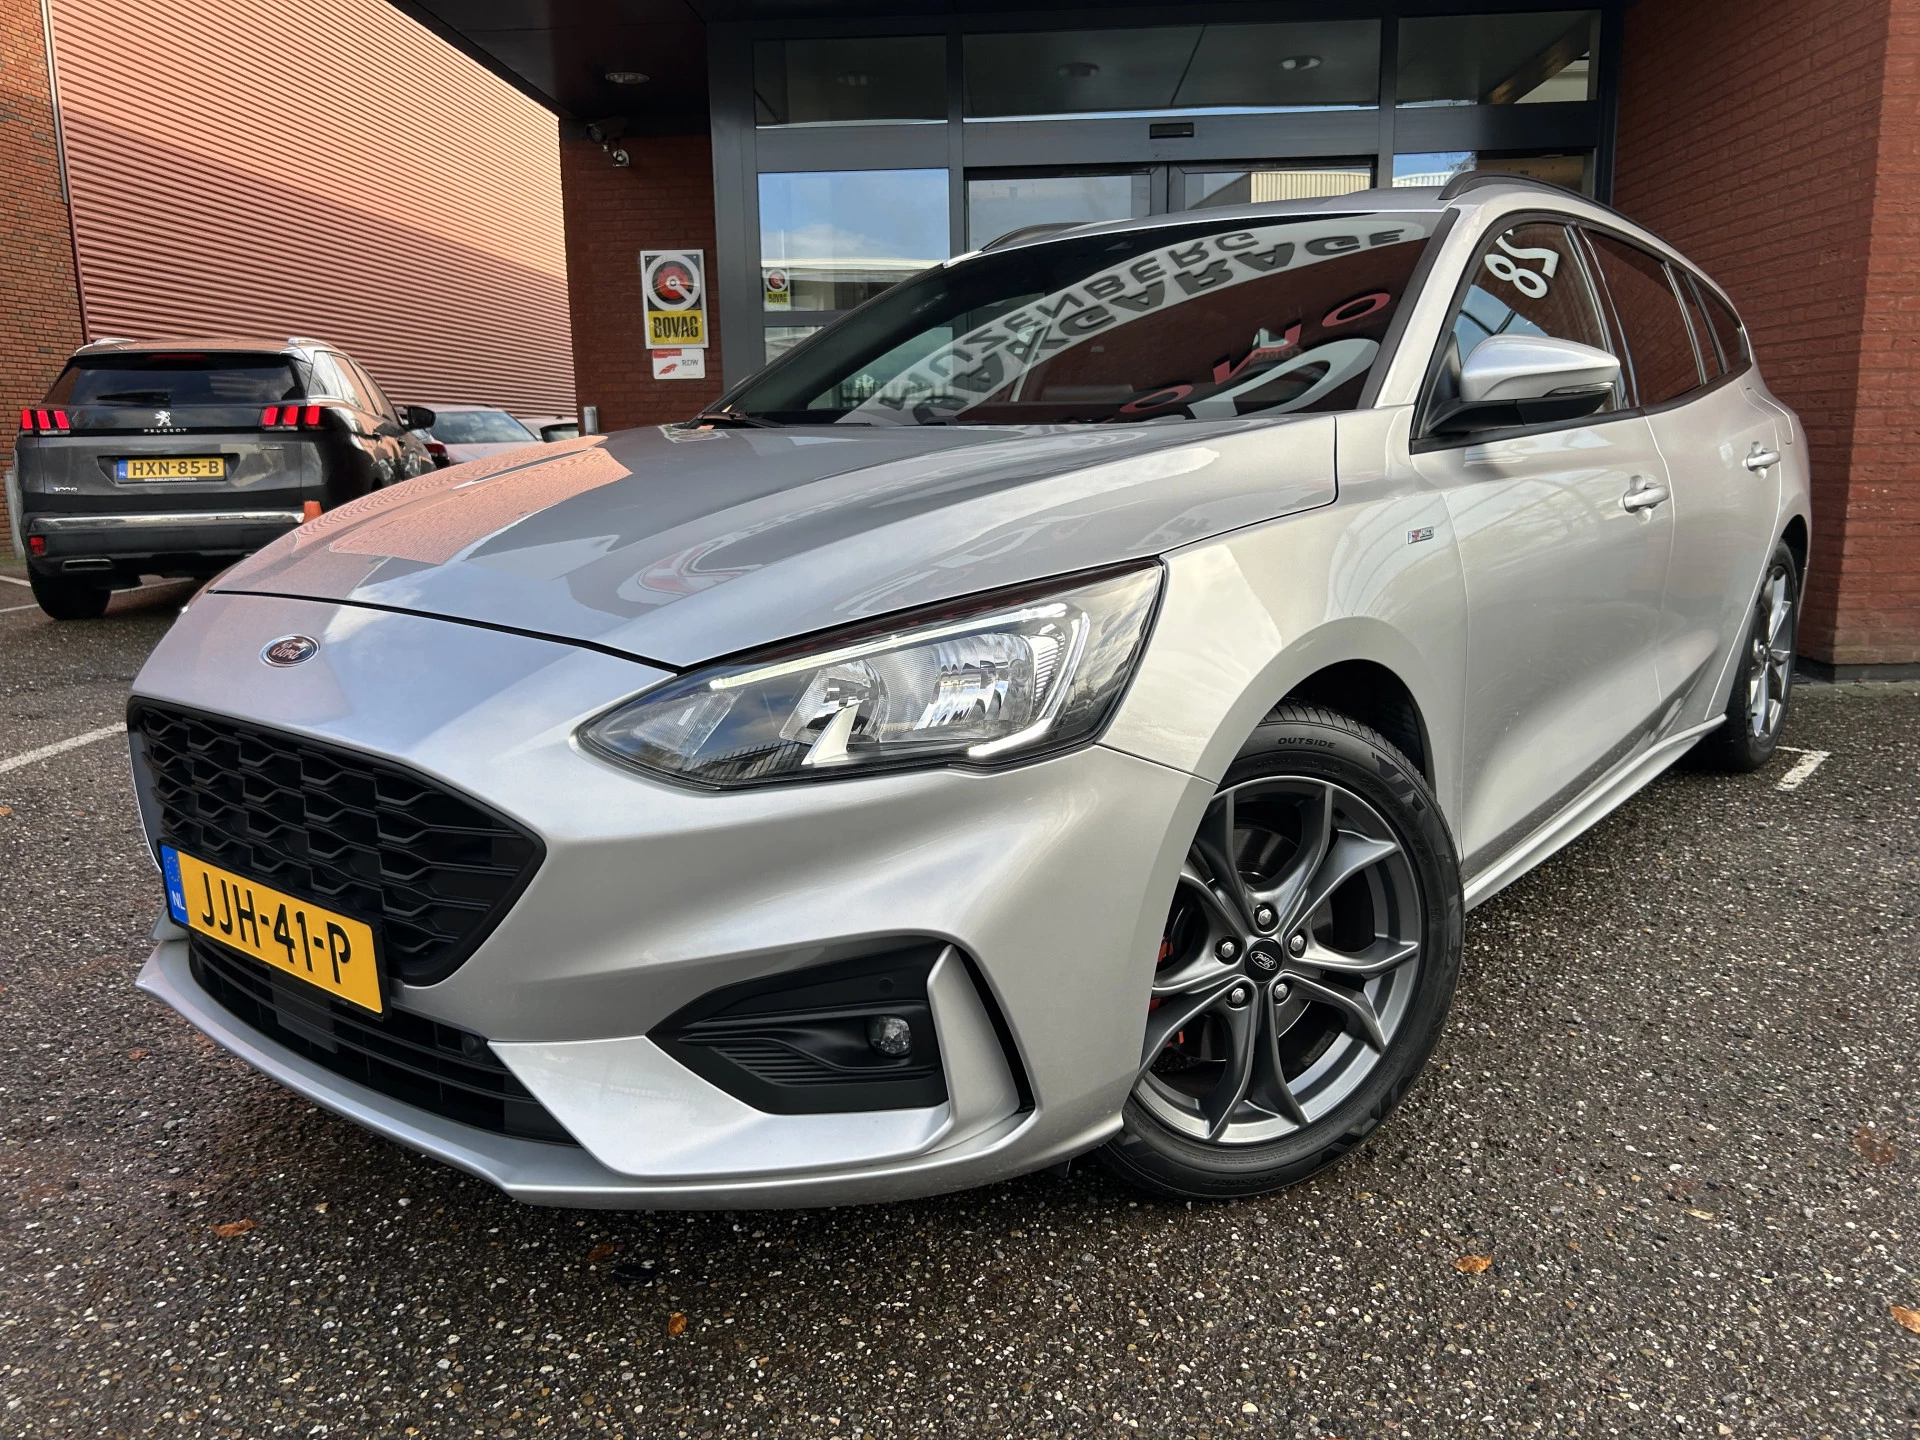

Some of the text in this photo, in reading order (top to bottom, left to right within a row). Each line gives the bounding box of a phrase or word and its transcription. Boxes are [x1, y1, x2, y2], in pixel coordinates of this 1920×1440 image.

[653, 316, 699, 338] BOVAG
[132, 460, 220, 476] HXN-85-B
[271, 641, 307, 660] Ford
[1277, 737, 1337, 749] OUTSIDE
[171, 889, 187, 912] NL
[202, 871, 352, 985] JJH-41-P
[1255, 953, 1275, 969] Ford
